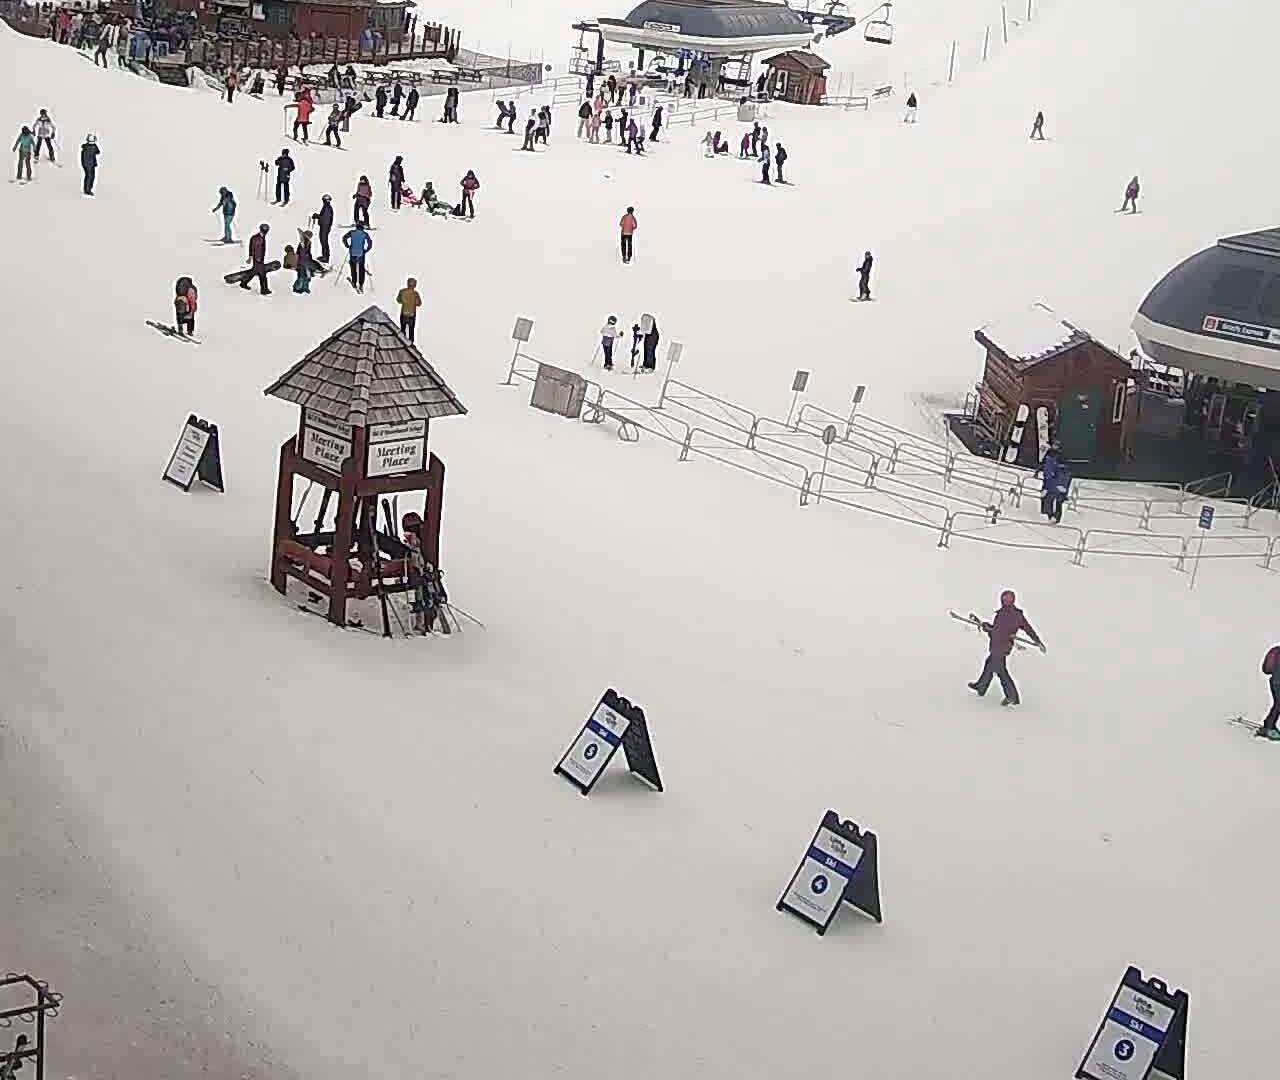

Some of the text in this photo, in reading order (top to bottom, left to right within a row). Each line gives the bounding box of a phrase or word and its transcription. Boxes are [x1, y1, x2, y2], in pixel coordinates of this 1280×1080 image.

[311, 432, 345, 455] Meeting
[376, 443, 417, 458] Meeting
[315, 446, 341, 463] Place
[382, 457, 411, 468] Place
[1118, 1043, 1130, 1057] 3
